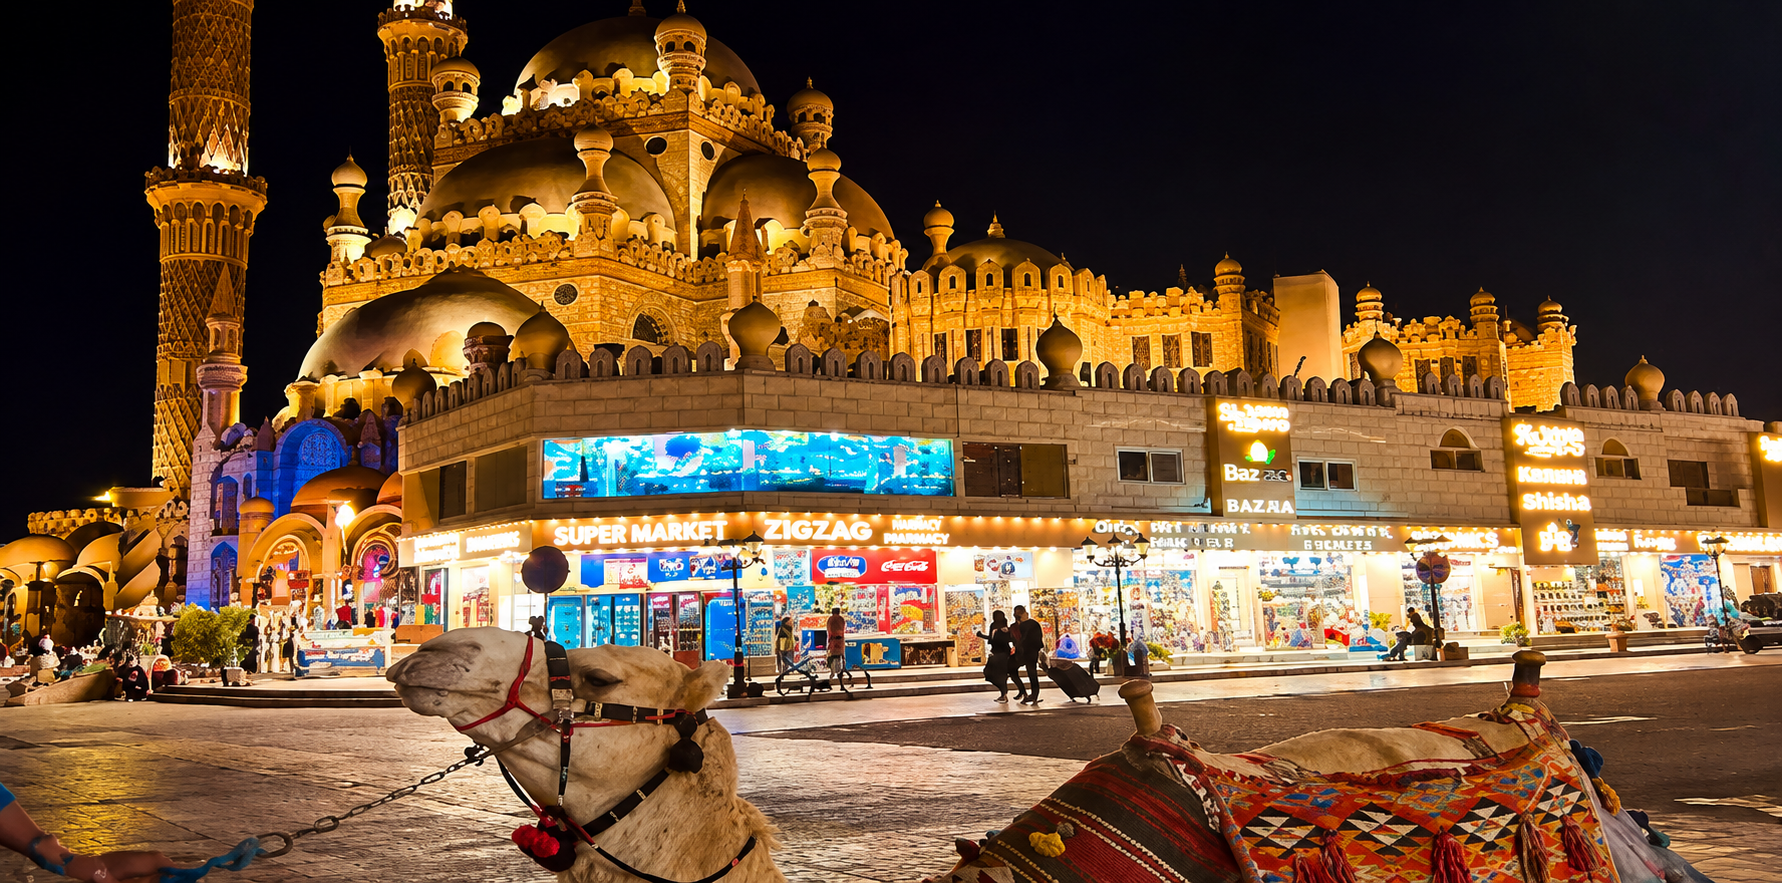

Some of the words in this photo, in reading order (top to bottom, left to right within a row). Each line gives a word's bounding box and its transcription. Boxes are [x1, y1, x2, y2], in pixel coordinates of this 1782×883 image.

[1522, 491, 1592, 512] Shisha
[553, 524, 627, 546] SUPER
[630, 520, 728, 543] MARKET
[763, 519, 873, 541] ZIGZAG
